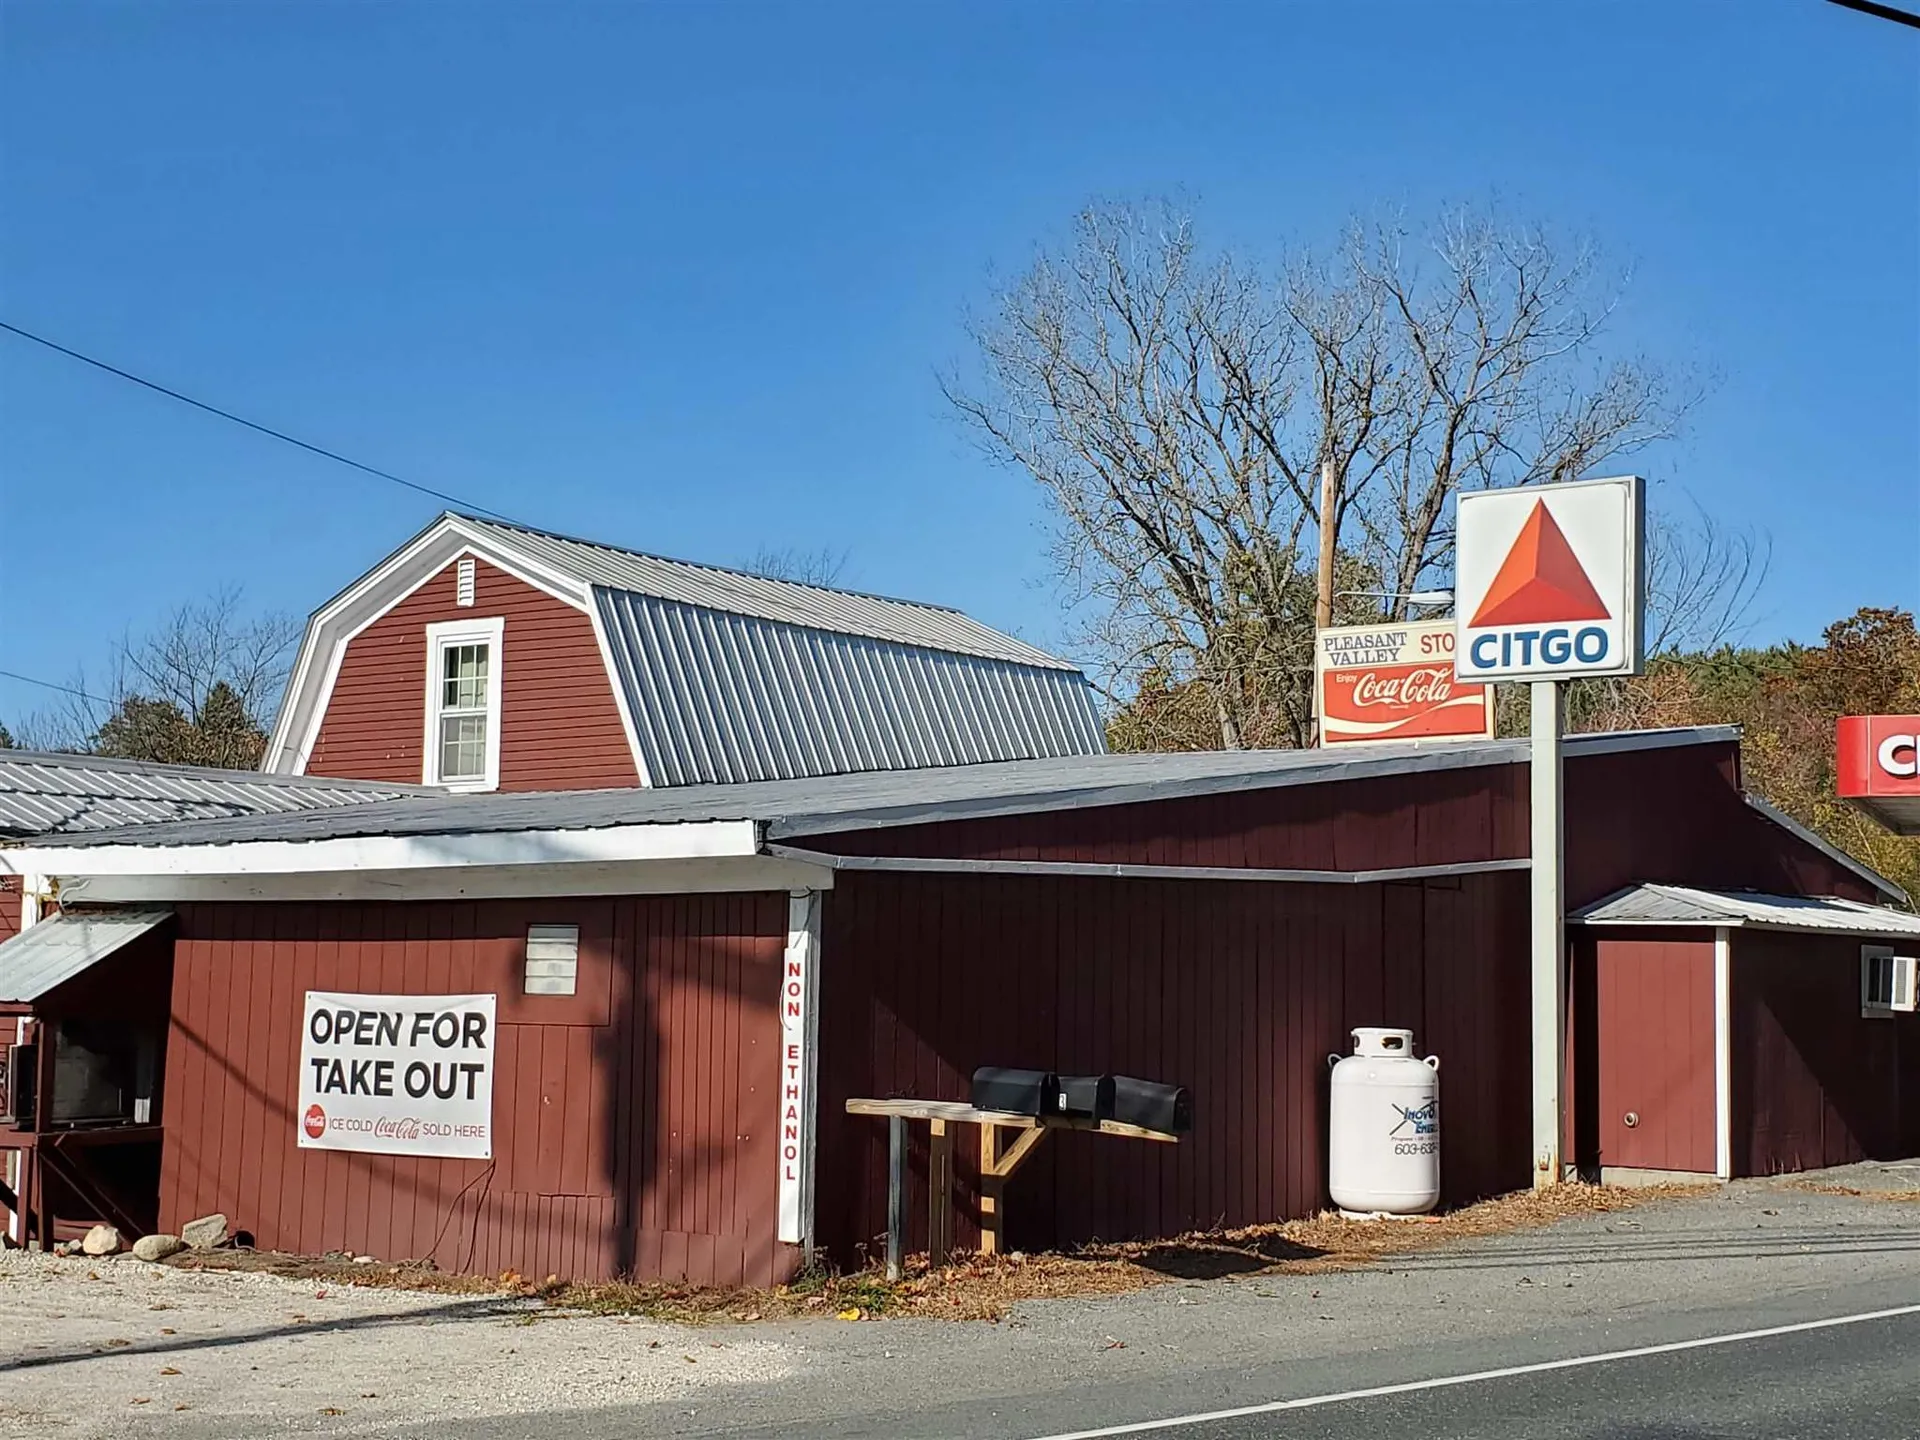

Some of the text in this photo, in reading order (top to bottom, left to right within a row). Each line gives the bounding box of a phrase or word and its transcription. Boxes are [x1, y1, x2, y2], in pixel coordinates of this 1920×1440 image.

[1324, 632, 1408, 652] PLEASANT
[1329, 648, 1400, 666] VALLEY
[1470, 627, 1609, 669] CITGO
[1335, 673, 1358, 684] Enjoy
[310, 1008, 487, 1049] OPEN FOR
[311, 1057, 485, 1100] TAKE OUT
[784, 962, 801, 1181] NON ETHANOL
[329, 1118, 344, 1130] ICE
[346, 1119, 373, 1132] COLD
[423, 1123, 451, 1137] SOLD
[455, 1125, 486, 1138] HERE
